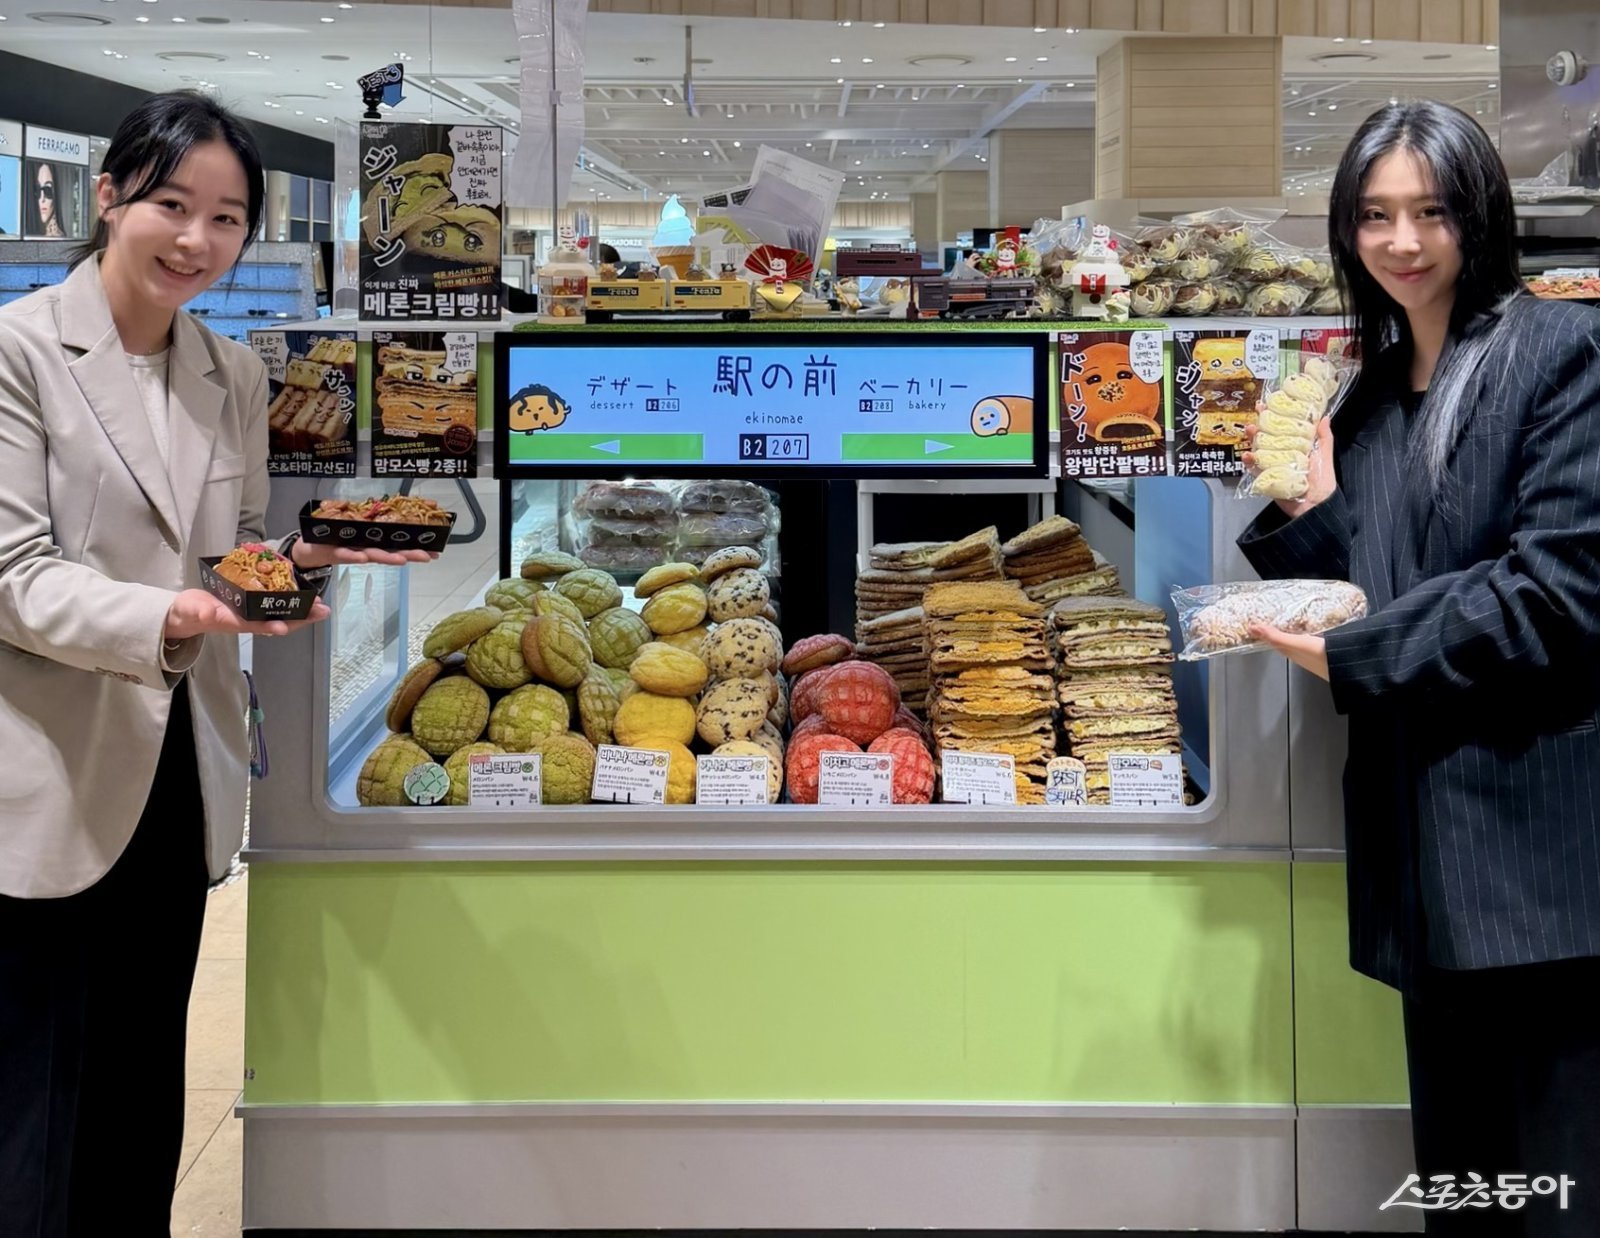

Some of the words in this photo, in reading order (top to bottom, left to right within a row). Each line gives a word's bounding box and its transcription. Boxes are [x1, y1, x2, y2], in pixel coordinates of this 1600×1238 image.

[38, 137, 80, 155] FERRAGAMO
[470, 155, 486, 165] 지금
[363, 145, 406, 268] ジャーン
[398, 277, 419, 290] 진짜
[364, 292, 498, 317] 메론크림빵!!
[713, 354, 838, 397] 駅の前
[587, 376, 677, 396] デザート
[859, 377, 968, 397] ベーカリー
[590, 400, 634, 410] dessert
[647, 401, 658, 410] B2
[860, 401, 872, 411] B2
[908, 400, 947, 412] bakery
[1062, 353, 1087, 442] ドーン!
[1176, 360, 1205, 440] ジャン!
[745, 411, 804, 425] ekinomae
[743, 439, 763, 456] B2
[772, 439, 803, 456] 207
[374, 458, 431, 474] 맘모스빵
[433, 459, 468, 474] 2종!!
[1065, 456, 1165, 475] 왕밤단팥빵!!
[260, 596, 301, 609] 駅の前
[1052, 770, 1081, 786] BEST
[1047, 787, 1086, 803] SELLER
